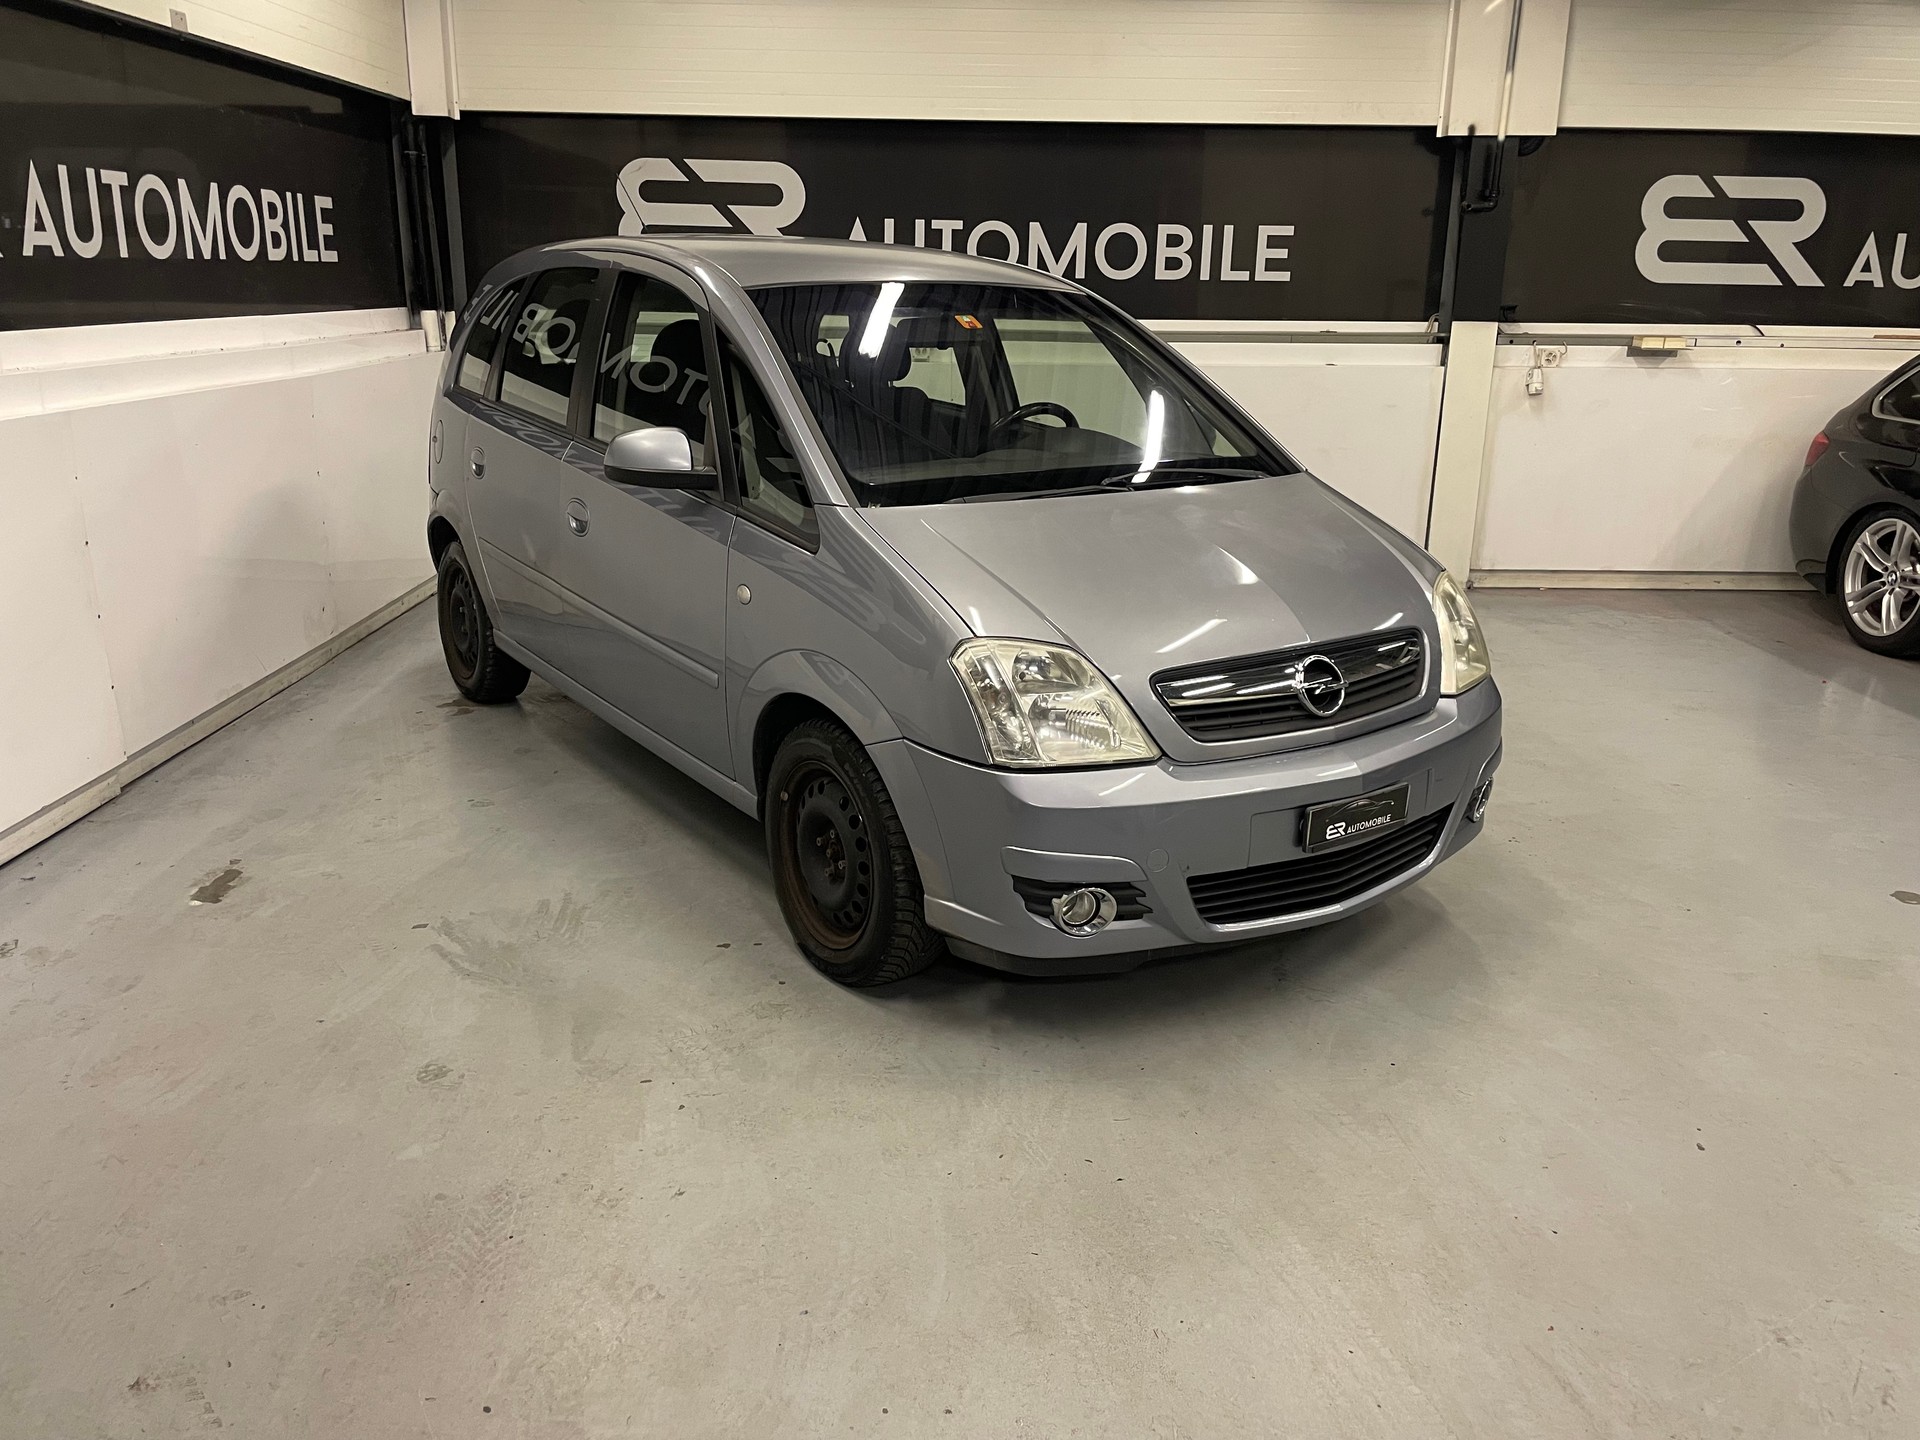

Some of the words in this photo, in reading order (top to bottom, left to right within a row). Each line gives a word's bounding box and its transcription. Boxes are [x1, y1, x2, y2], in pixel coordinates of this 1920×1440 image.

[22, 158, 339, 262] AUTOMOBILE
[1635, 174, 1827, 287] ER
[1346, 813, 1392, 834] AUTOMOBILE
